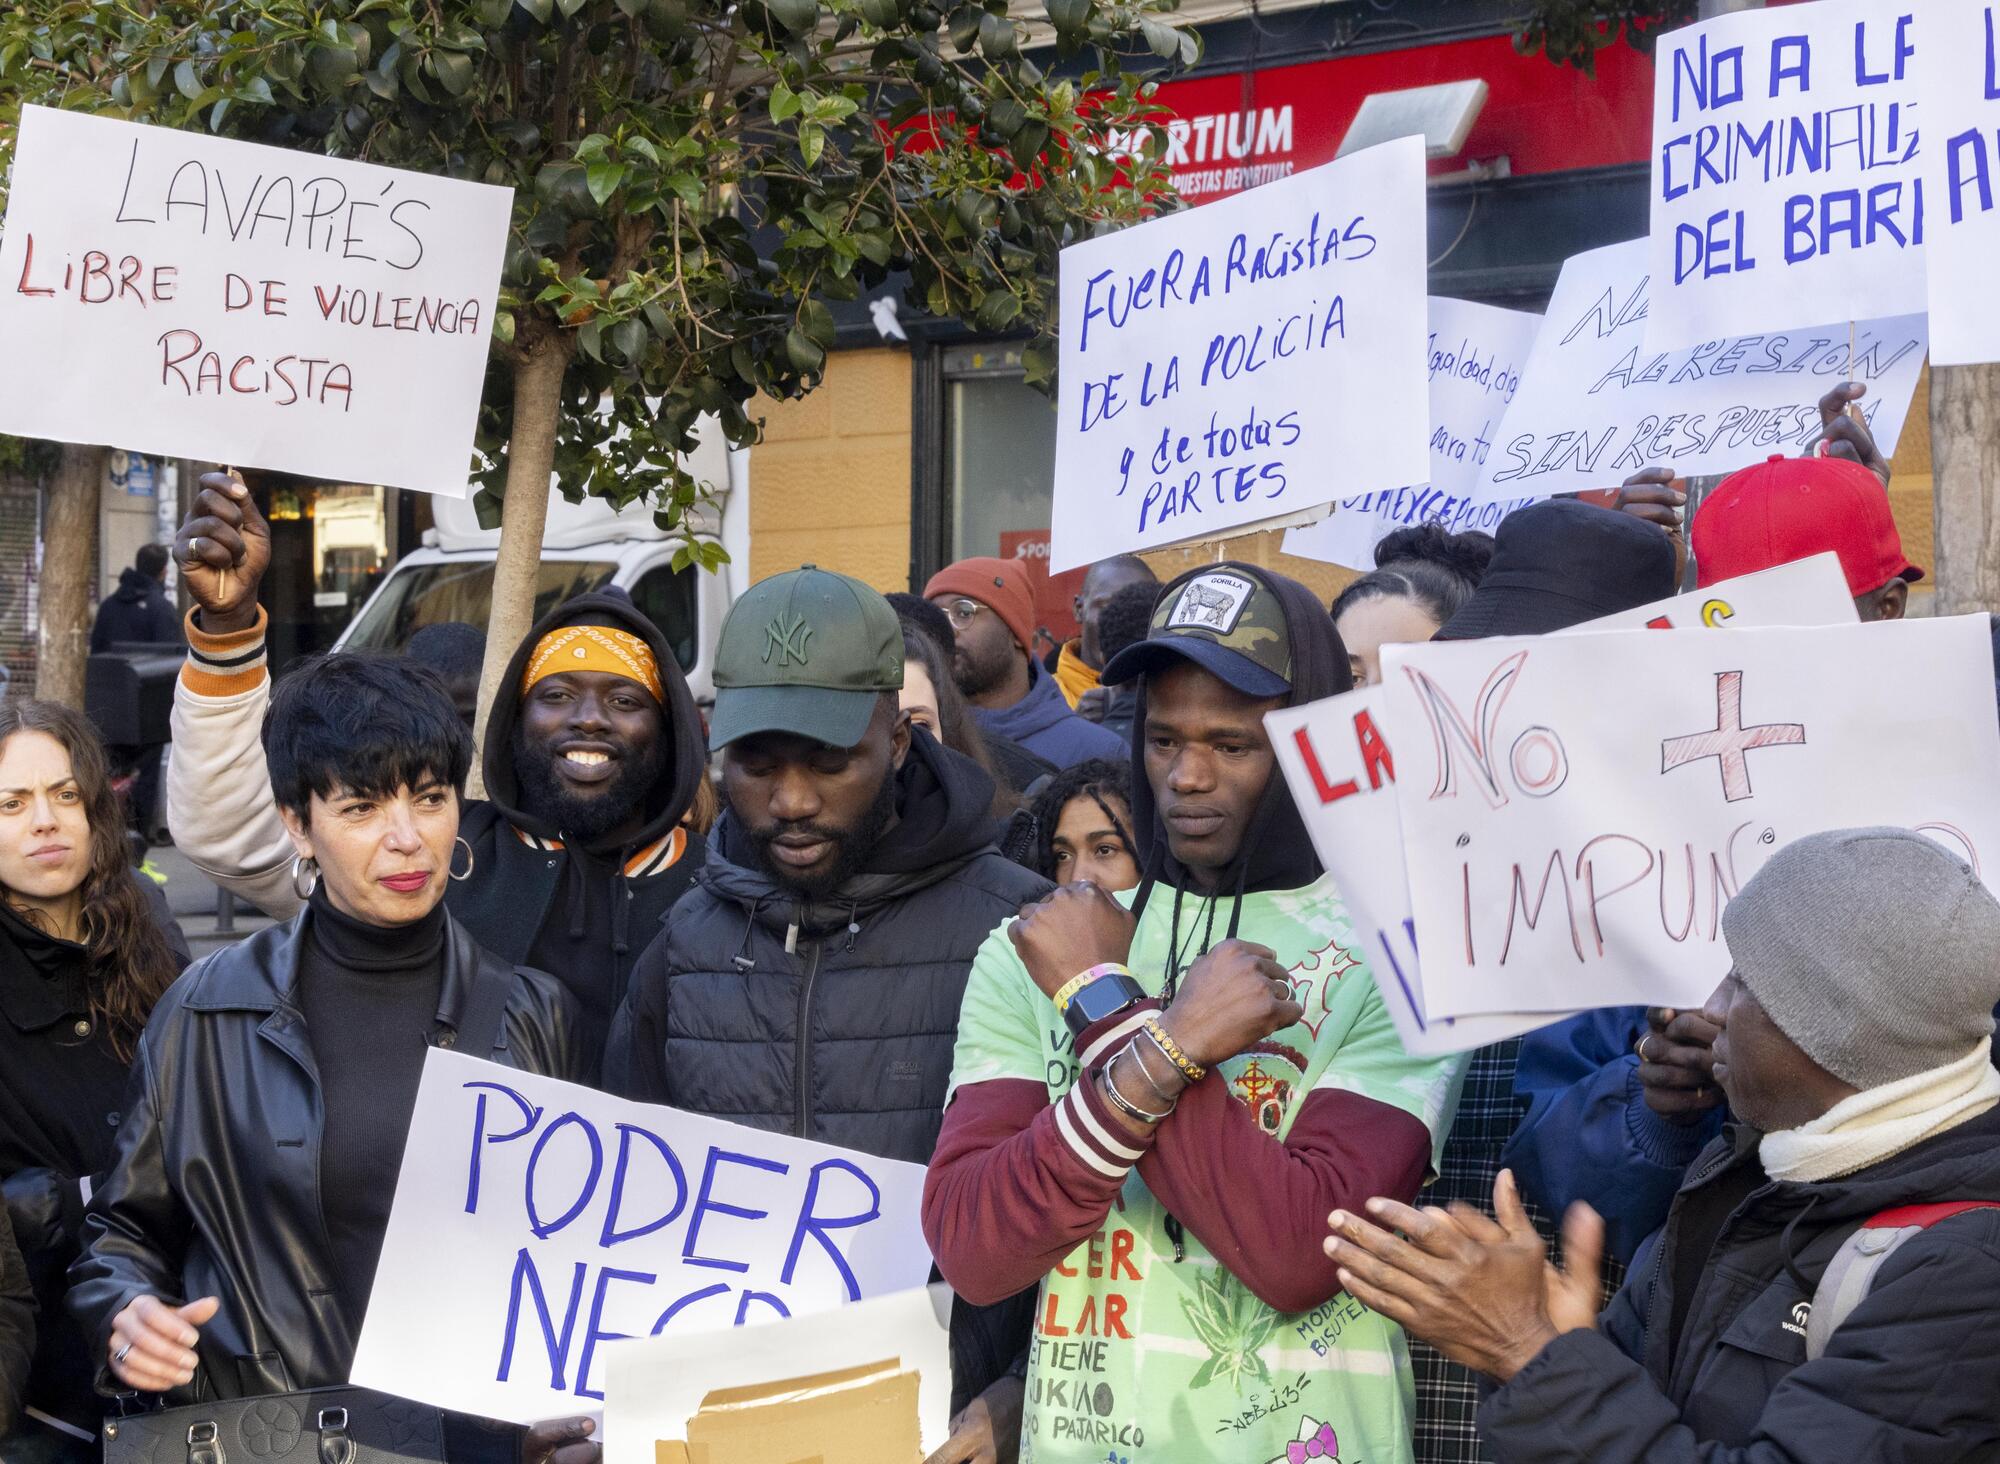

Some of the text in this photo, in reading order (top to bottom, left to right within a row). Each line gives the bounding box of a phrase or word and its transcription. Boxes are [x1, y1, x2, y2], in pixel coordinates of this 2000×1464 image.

[1673, 34, 1744, 123] NO
[1769, 34, 1811, 98] A
[1674, 209, 1755, 286] DEL
[225, 273, 288, 317] DE
[1079, 373, 1127, 432] DE
[1140, 356, 1179, 408] LA
[1152, 426, 1193, 476] de
[1492, 425, 1618, 483] SIN
[1138, 461, 1287, 533] PARTES
[1211, 577, 1243, 590] GORILLA
[462, 1081, 881, 1302] PODER
[1052, 1415, 1145, 1448] PAJARICO
